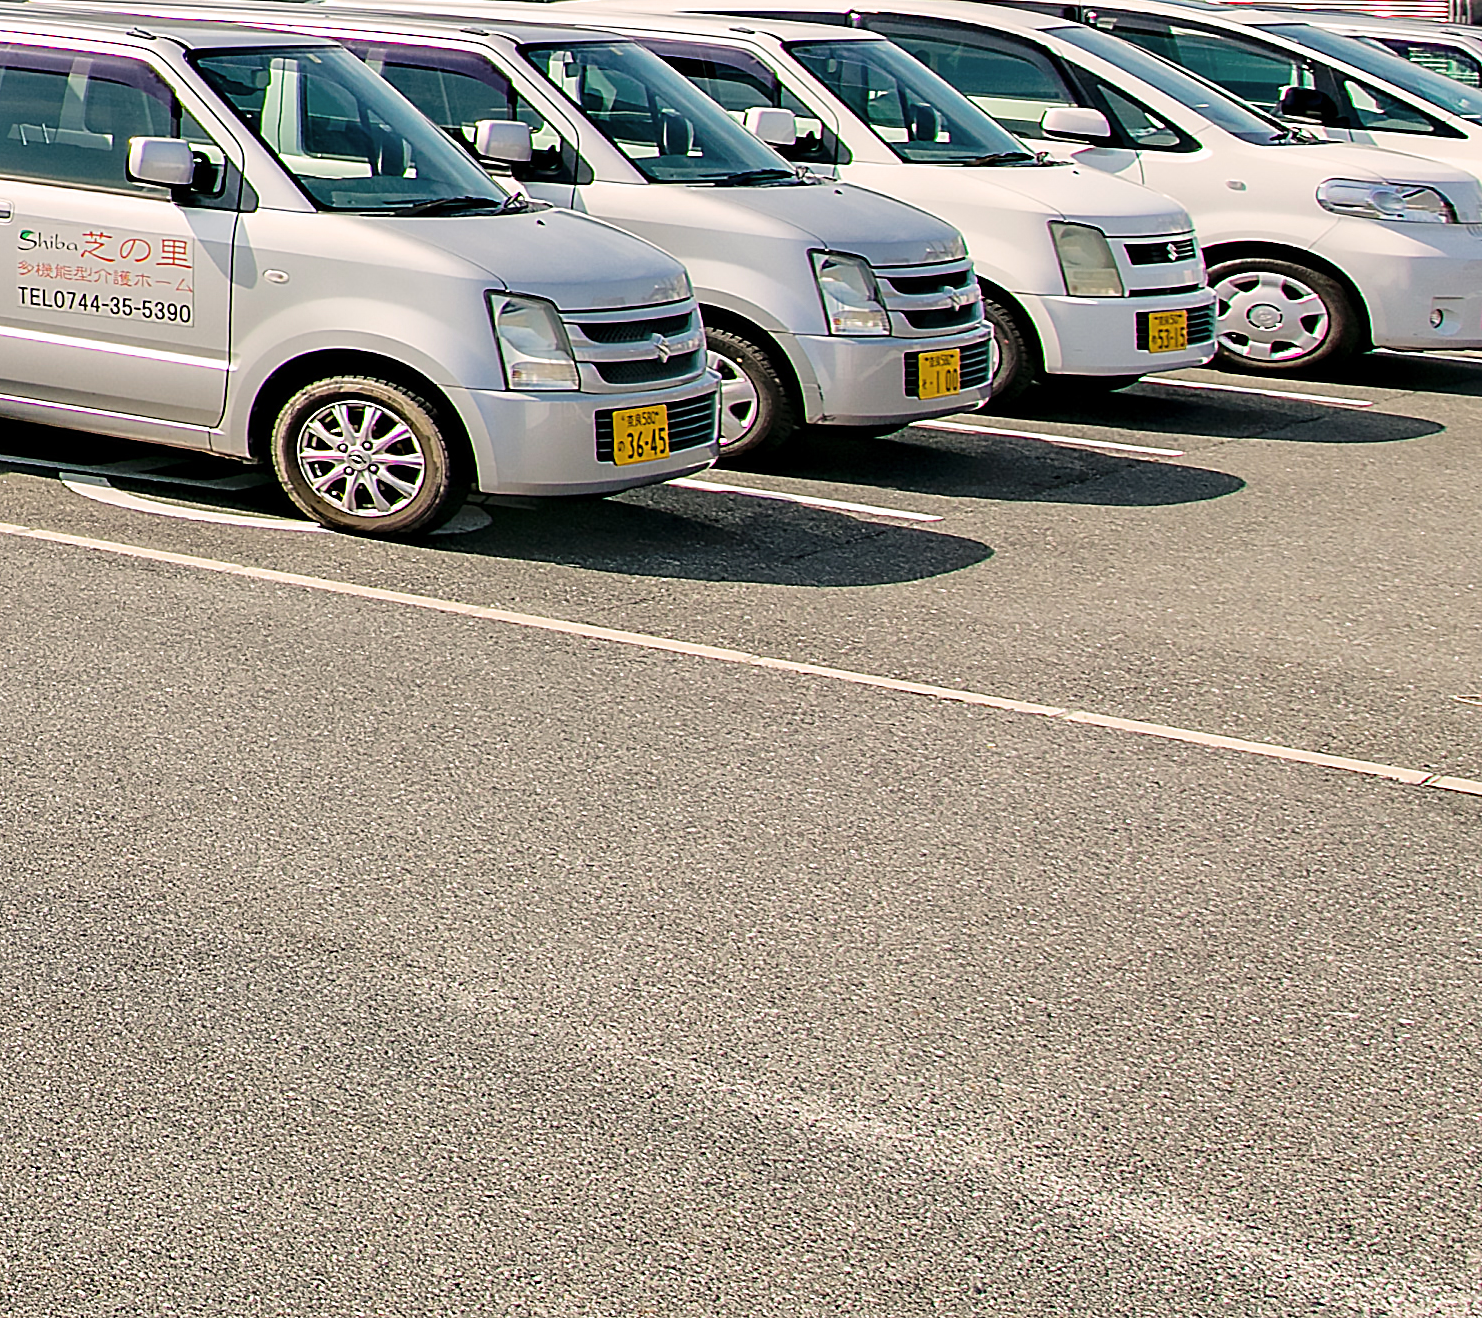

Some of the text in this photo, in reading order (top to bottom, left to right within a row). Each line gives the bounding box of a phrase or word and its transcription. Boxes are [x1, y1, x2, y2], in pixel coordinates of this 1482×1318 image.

[17, 230, 194, 270] Shiba 芝の里
[17, 260, 194, 294] 多機能型介護ホーム
[17, 286, 192, 324] TEL0744-35-5390
